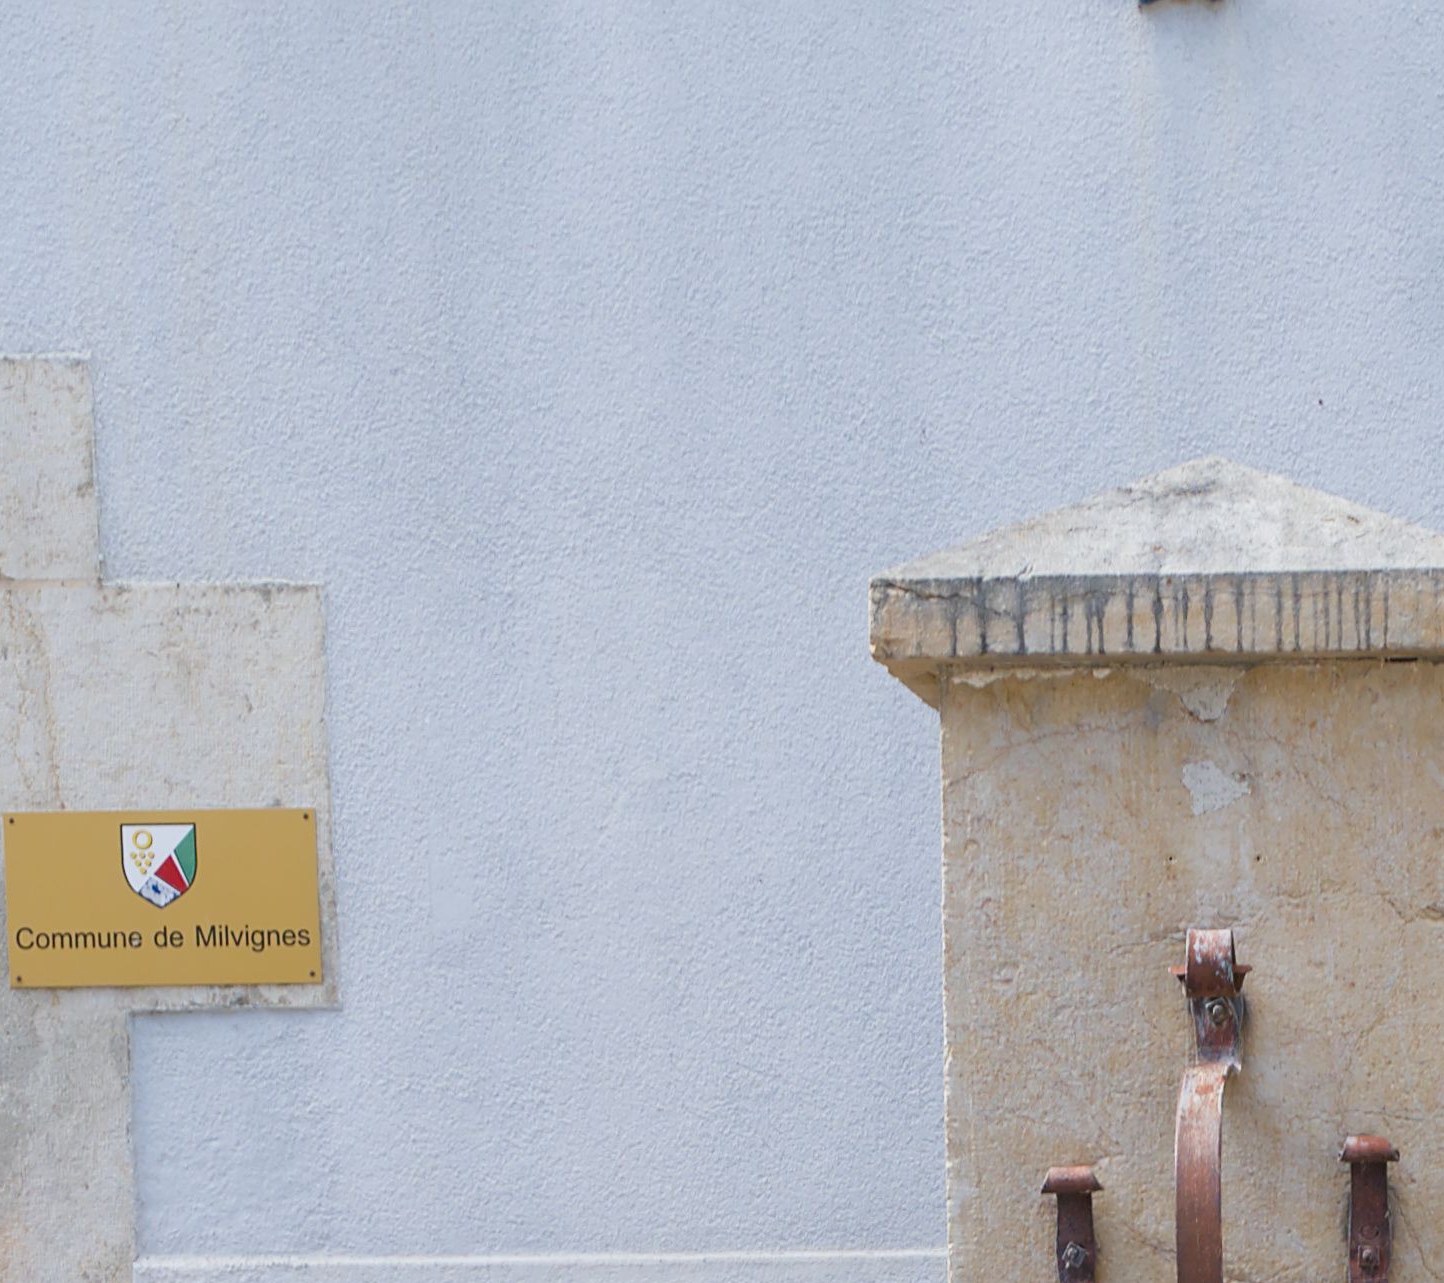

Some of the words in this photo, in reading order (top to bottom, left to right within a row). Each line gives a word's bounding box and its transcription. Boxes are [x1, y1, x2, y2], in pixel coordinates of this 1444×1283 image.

[15, 927, 143, 949] Commune
[154, 926, 184, 948] de
[195, 924, 311, 952] Milvignes
